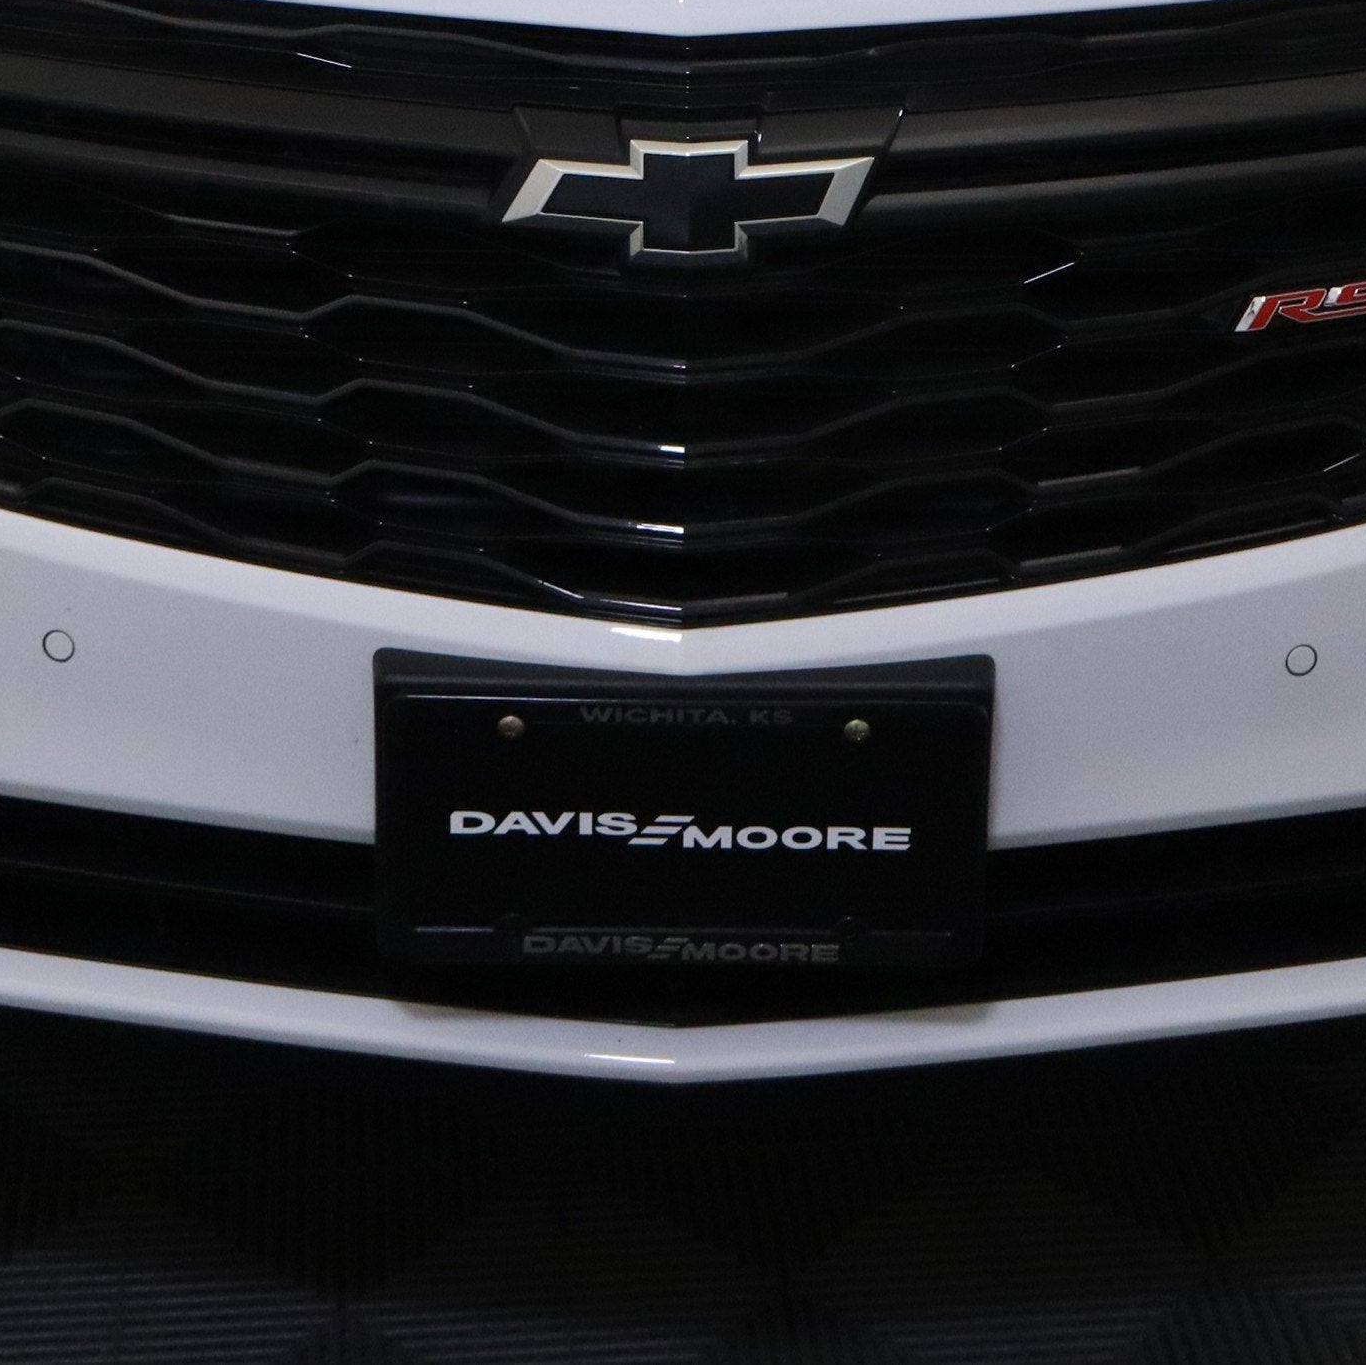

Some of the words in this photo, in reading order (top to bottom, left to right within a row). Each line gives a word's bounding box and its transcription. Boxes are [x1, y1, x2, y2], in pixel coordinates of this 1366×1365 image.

[750, 708, 793, 725] KS
[450, 811, 636, 835] DAVIS
[682, 827, 911, 850] MOORE
[523, 935, 653, 954] DAVIS
[681, 943, 840, 962] MOORE
